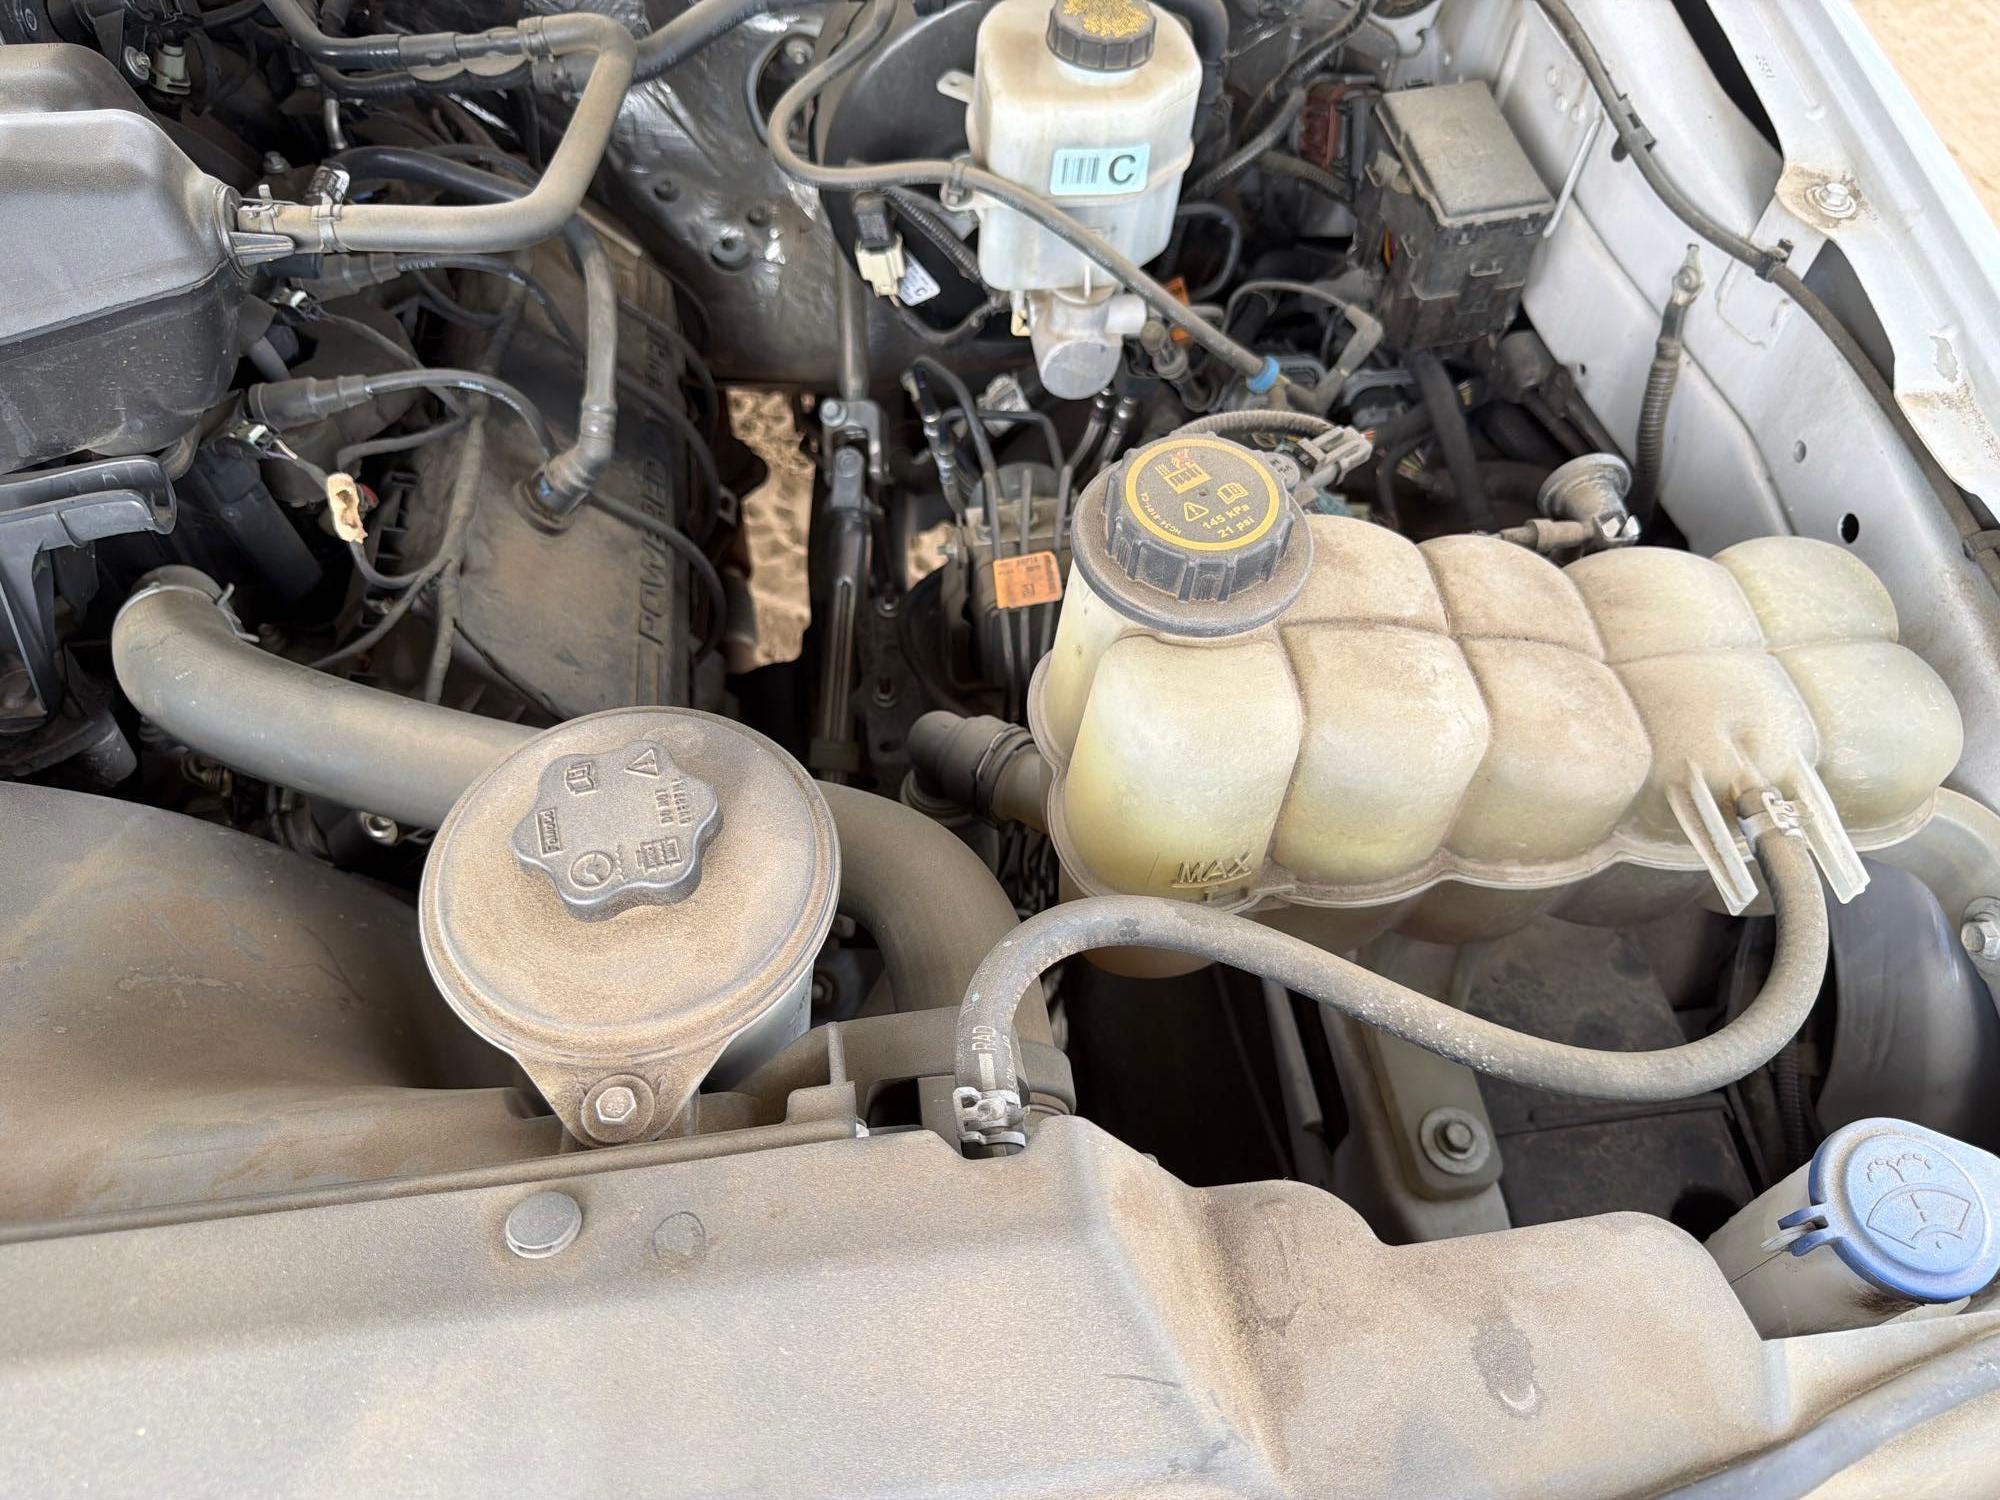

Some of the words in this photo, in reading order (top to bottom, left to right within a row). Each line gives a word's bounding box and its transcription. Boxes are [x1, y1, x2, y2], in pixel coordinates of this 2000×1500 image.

[1108, 154, 1136, 185] C
[1202, 514, 1226, 530] 145
[1225, 504, 1250, 519] kPa
[1217, 526, 1235, 538] 21
[1236, 515, 1255, 532] psi
[1177, 849, 1252, 883] MAX
[972, 1026, 998, 1051] RAD
